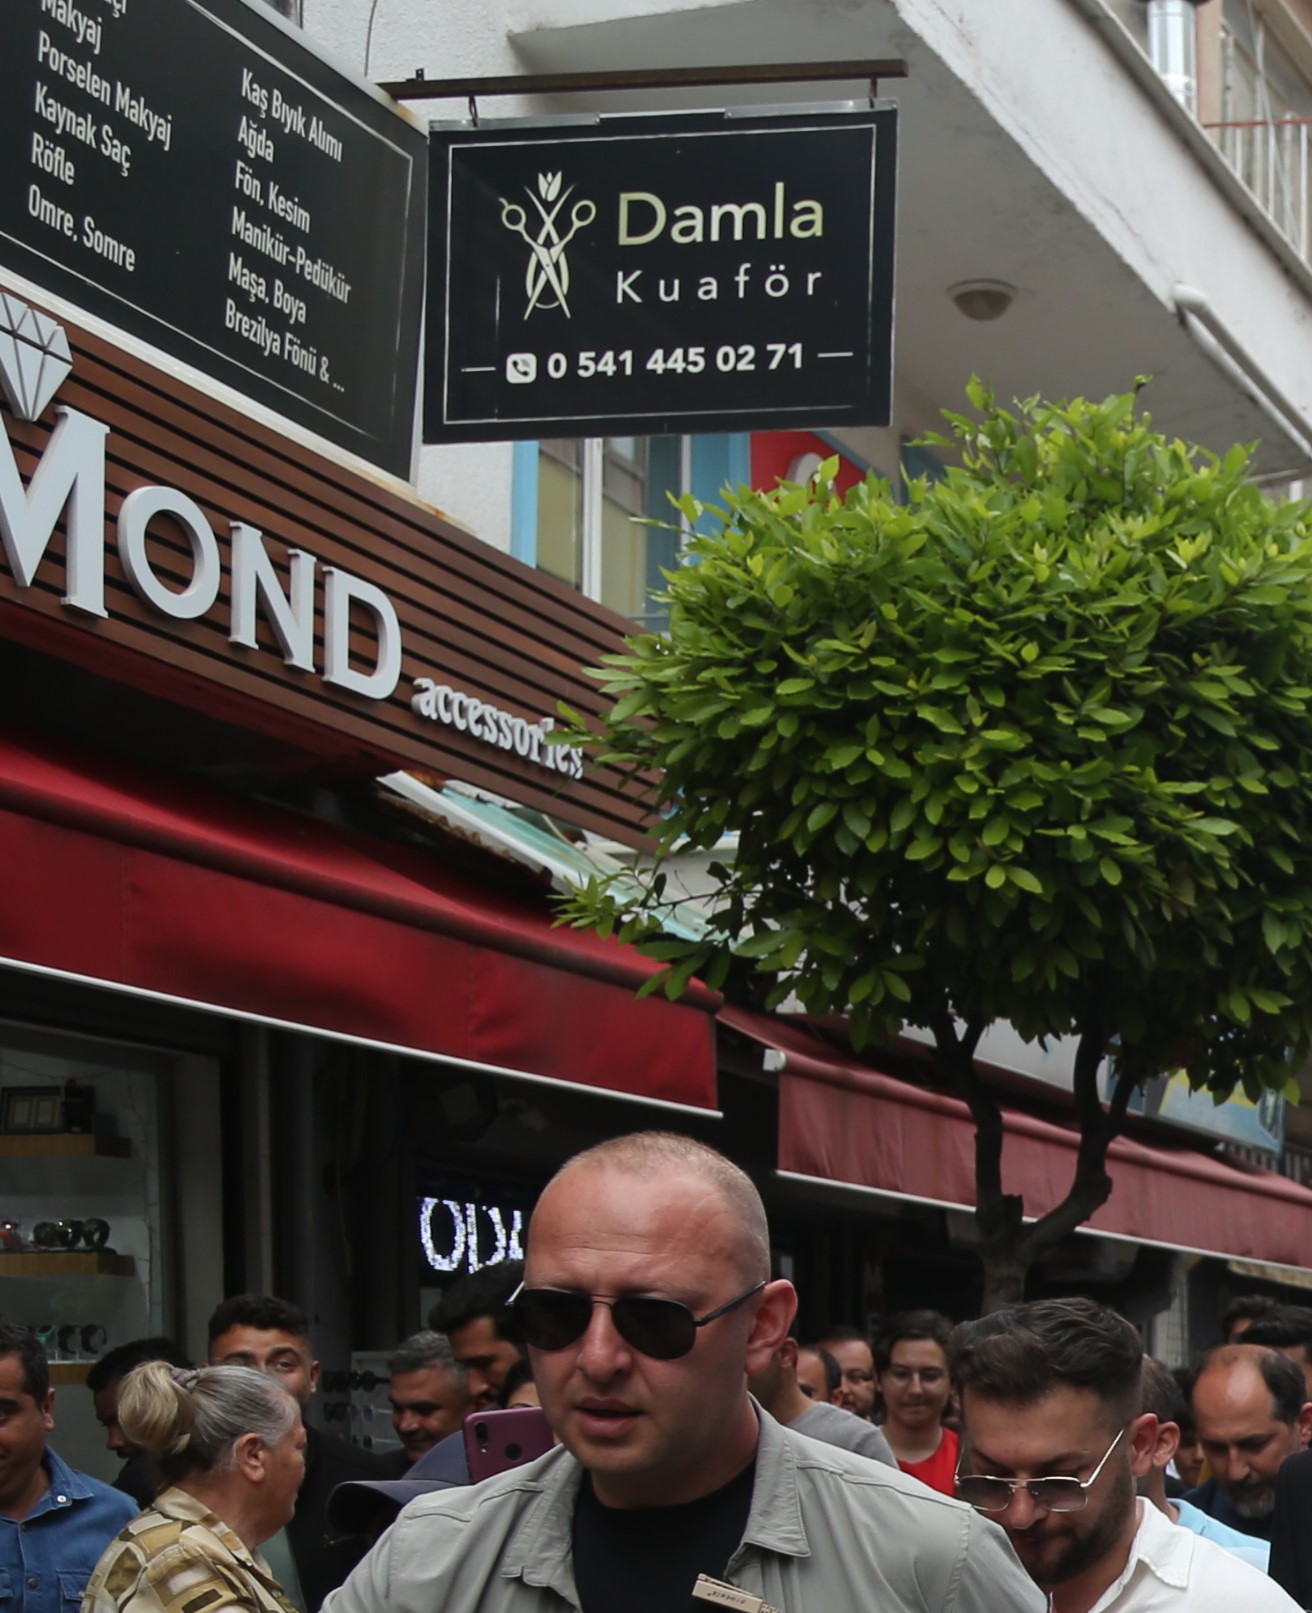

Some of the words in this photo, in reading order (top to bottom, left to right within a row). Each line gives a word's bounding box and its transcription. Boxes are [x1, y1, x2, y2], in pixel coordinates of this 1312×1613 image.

[38, 30, 111, 105] Porselen
[115, 81, 172, 151] Makyaj
[241, 68, 269, 118] Kaş
[271, 88, 306, 137] Bıyık
[308, 116, 343, 162] Alımı
[31, 132, 75, 185] Röfle
[35, 81, 97, 149] Kaynak
[100, 124, 131, 177] Saç
[237, 115, 274, 163] Ağda
[235, 160, 264, 206] Fön,
[268, 181, 311, 233] Kesim
[618, 182, 824, 246] Damla
[83, 216, 136, 272] Somre
[232, 206, 351, 304] Manikür-Pedükür
[228, 252, 269, 303] Maşa,
[273, 279, 307, 325] Boya
[616, 263, 822, 304] Kuaför
[225, 298, 281, 356] Brezilya
[284, 332, 317, 375] Fönü
[319, 356, 330, 383] &
[547, 353, 567, 379] 0
[577, 350, 633, 377] 541
[646, 347, 705, 374] 445
[716, 345, 755, 371] 02
[766, 343, 803, 370] 71
[411, 677, 583, 779] accessories
